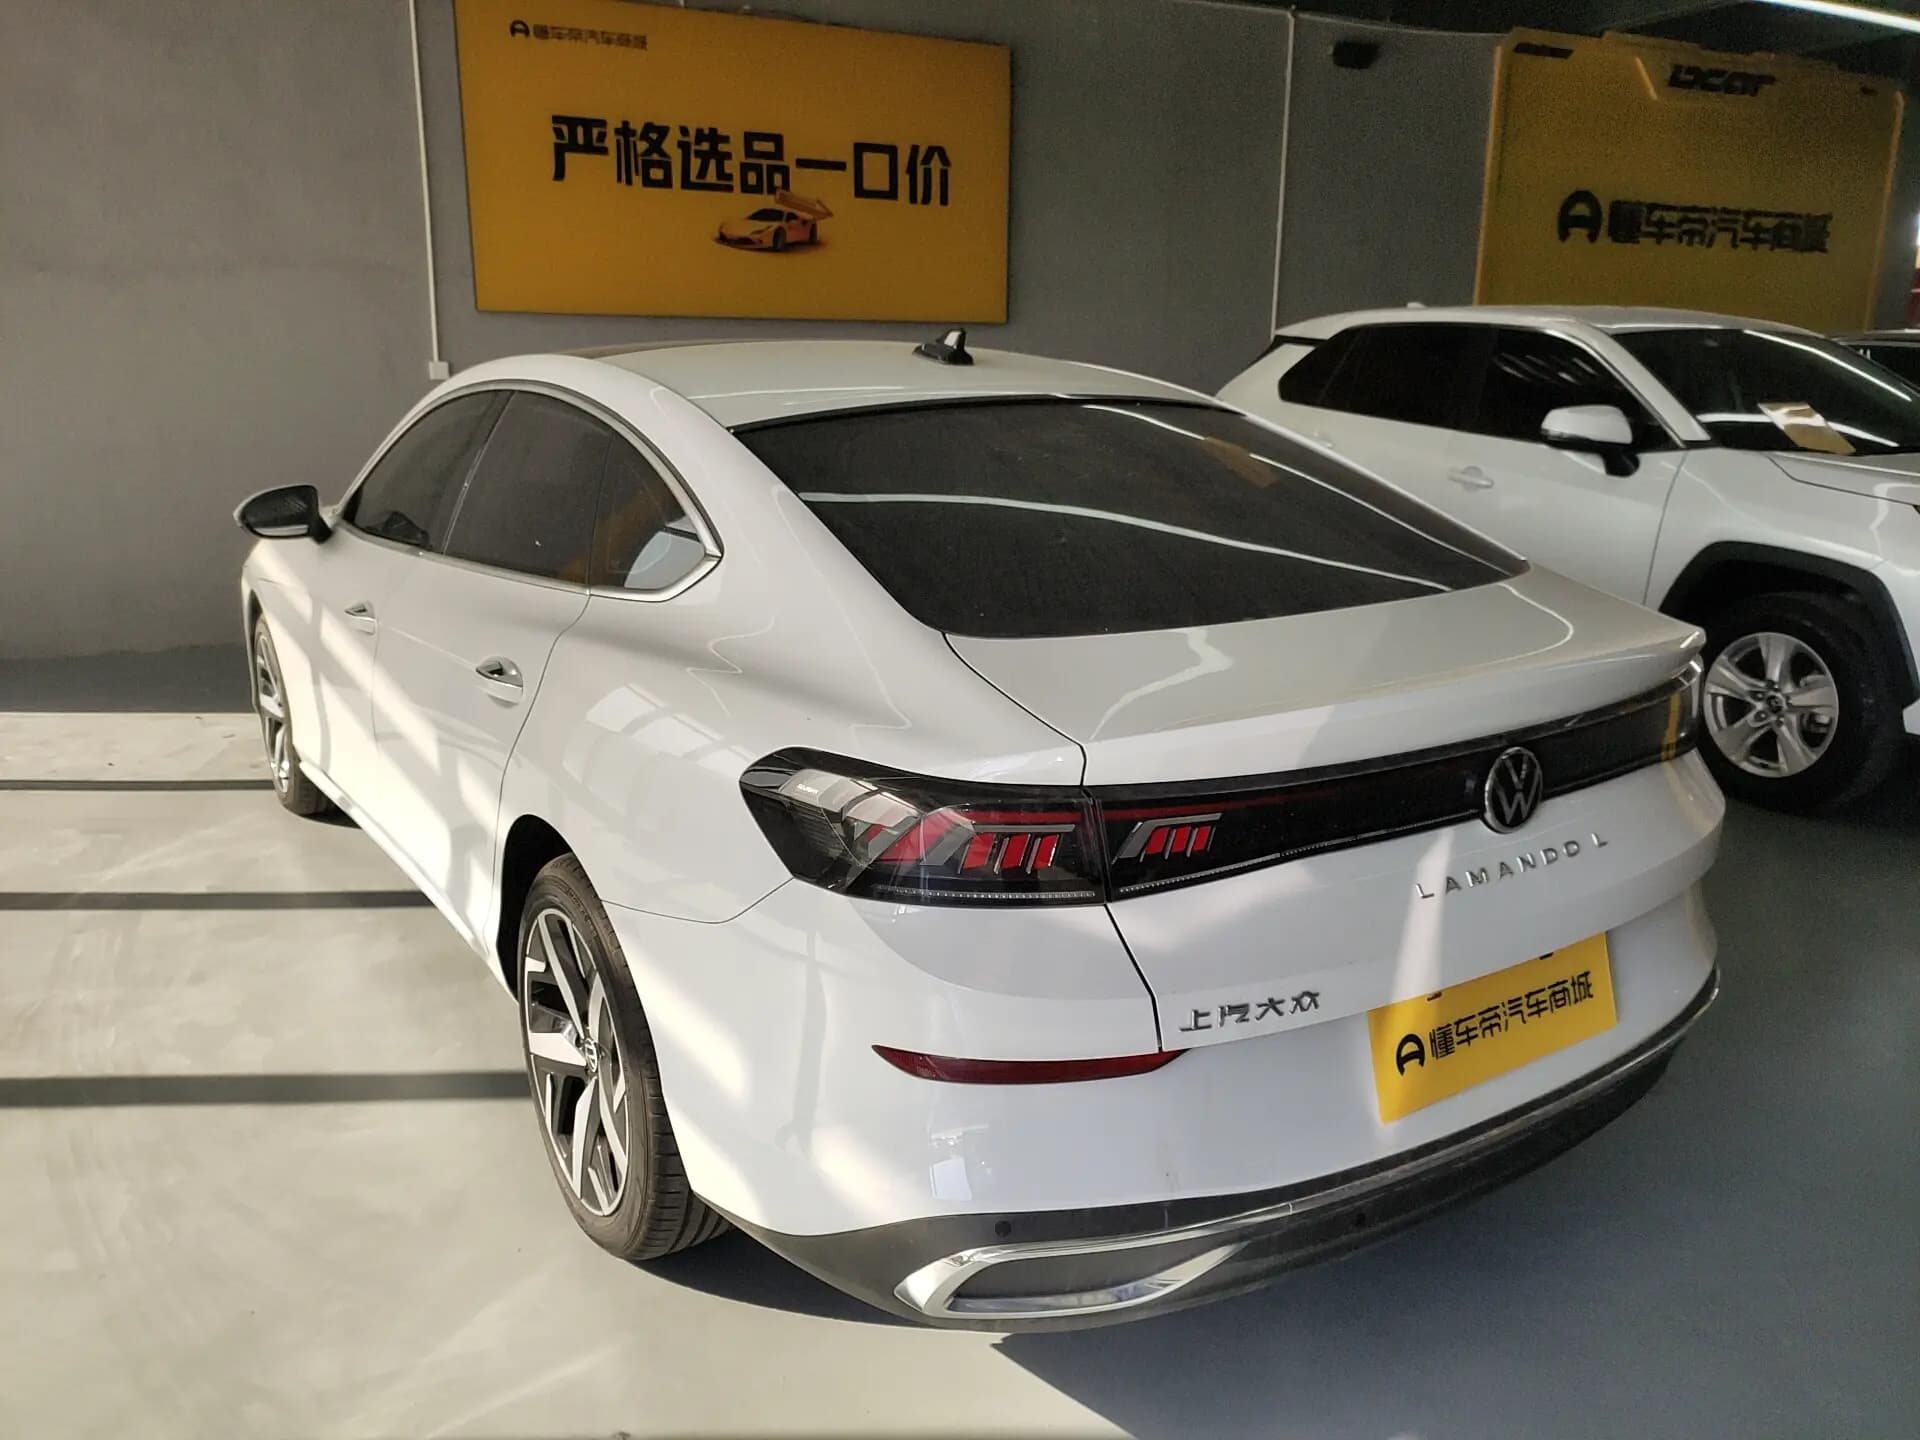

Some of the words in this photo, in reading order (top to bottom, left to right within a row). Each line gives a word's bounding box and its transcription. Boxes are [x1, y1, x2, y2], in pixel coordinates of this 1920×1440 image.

[551, 114, 952, 206] 严格选品一口价
[1415, 840, 1581, 899] LAMANDO
[1590, 832, 1609, 849] L
[1179, 989, 1320, 1032] 上汽大众
[1428, 970, 1594, 1060] 懂车帝汽车商城
